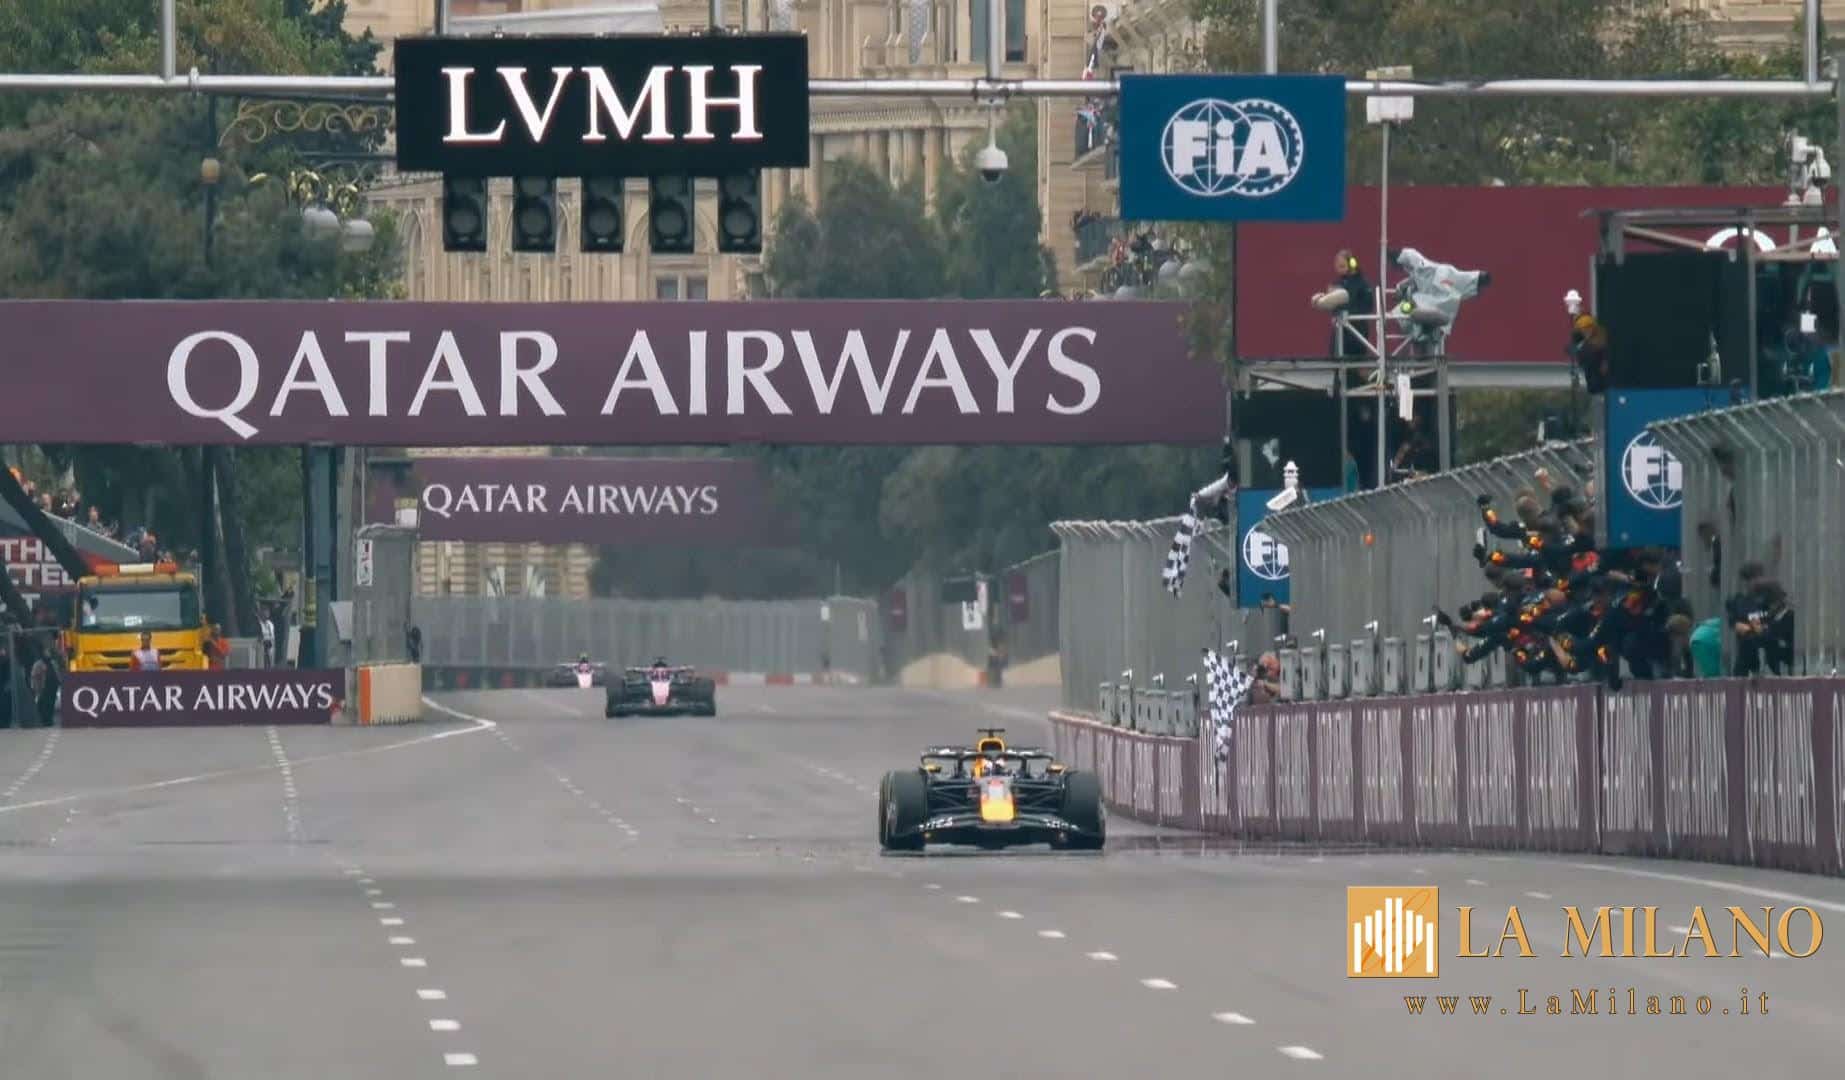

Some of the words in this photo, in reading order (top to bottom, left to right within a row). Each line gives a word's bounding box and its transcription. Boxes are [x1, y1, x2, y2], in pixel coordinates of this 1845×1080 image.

[441, 64, 764, 144] LVMH
[167, 329, 566, 439] QATAR
[600, 327, 1101, 417] AIRWAYS
[421, 483, 548, 518] QATAR
[559, 483, 720, 517] AIRWAYS
[72, 684, 184, 717] QATAR
[193, 682, 333, 711] AIRWAYS
